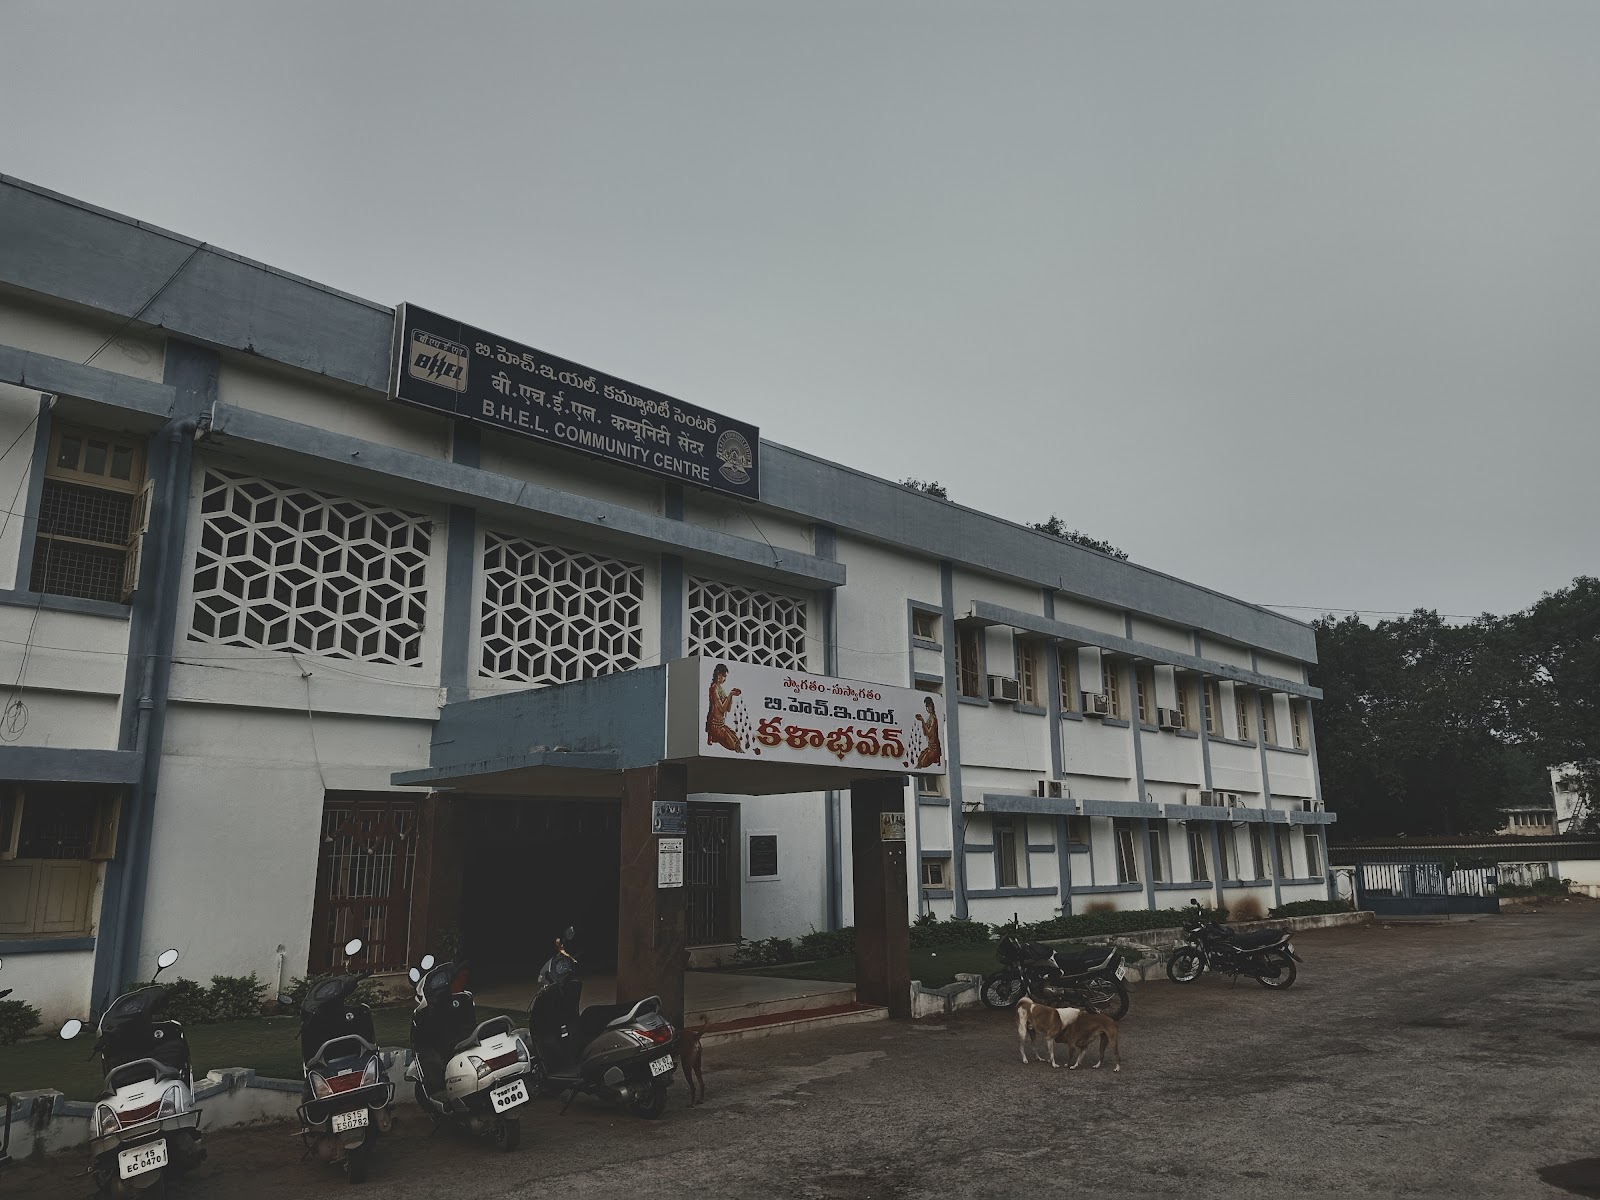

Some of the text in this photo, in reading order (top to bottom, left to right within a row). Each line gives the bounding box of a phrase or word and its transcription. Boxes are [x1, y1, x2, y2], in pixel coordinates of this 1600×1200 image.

[414, 351, 463, 381] BHEL
[673, 406, 717, 434] సెంటర్
[482, 399, 710, 481] B.H.E.L. COMMUNITY CENTRE
[678, 431, 705, 458] सेंटर
[756, 716, 905, 761] కళాభవన్
[498, 1091, 523, 1106] 9080
[127, 1156, 161, 1173] EC 0470
